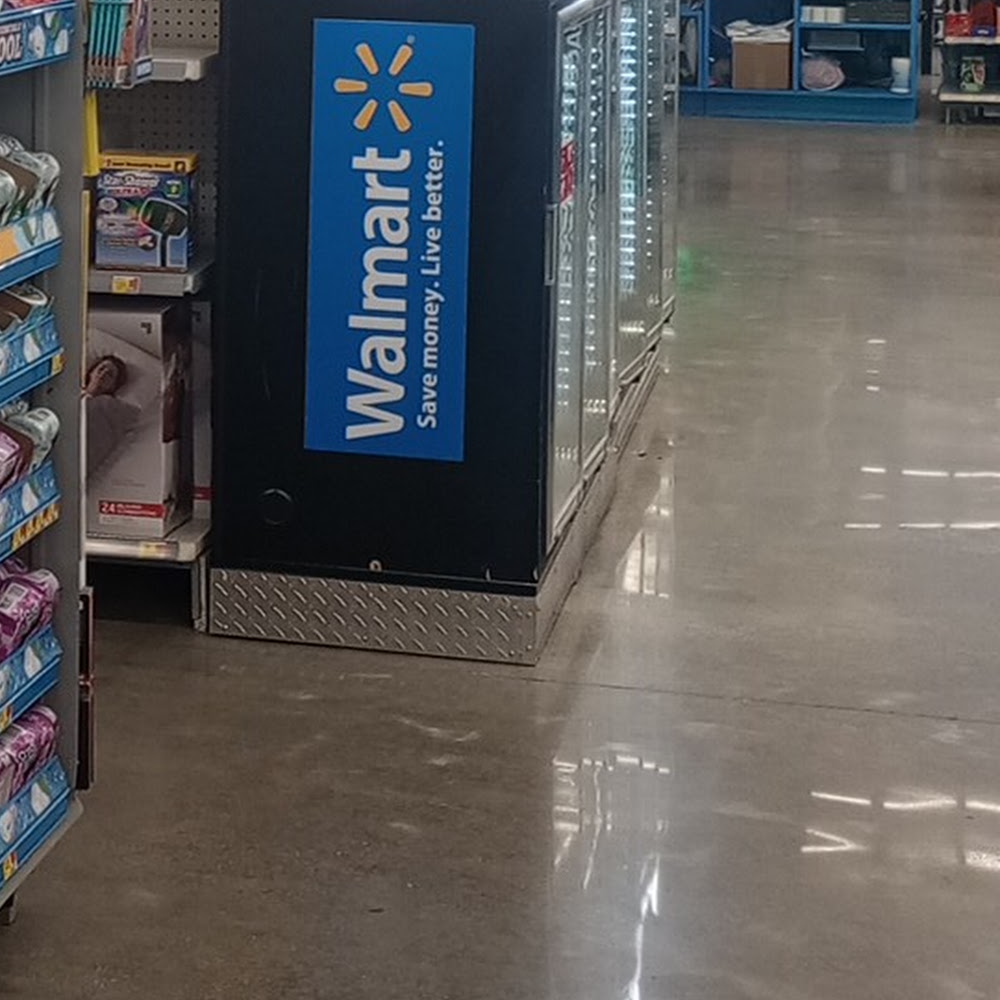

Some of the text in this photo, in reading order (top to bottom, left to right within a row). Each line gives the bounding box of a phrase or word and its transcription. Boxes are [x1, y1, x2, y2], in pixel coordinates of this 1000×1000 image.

[345, 146, 411, 440] Walmart
[416, 140, 445, 428] Save money. Live better.
